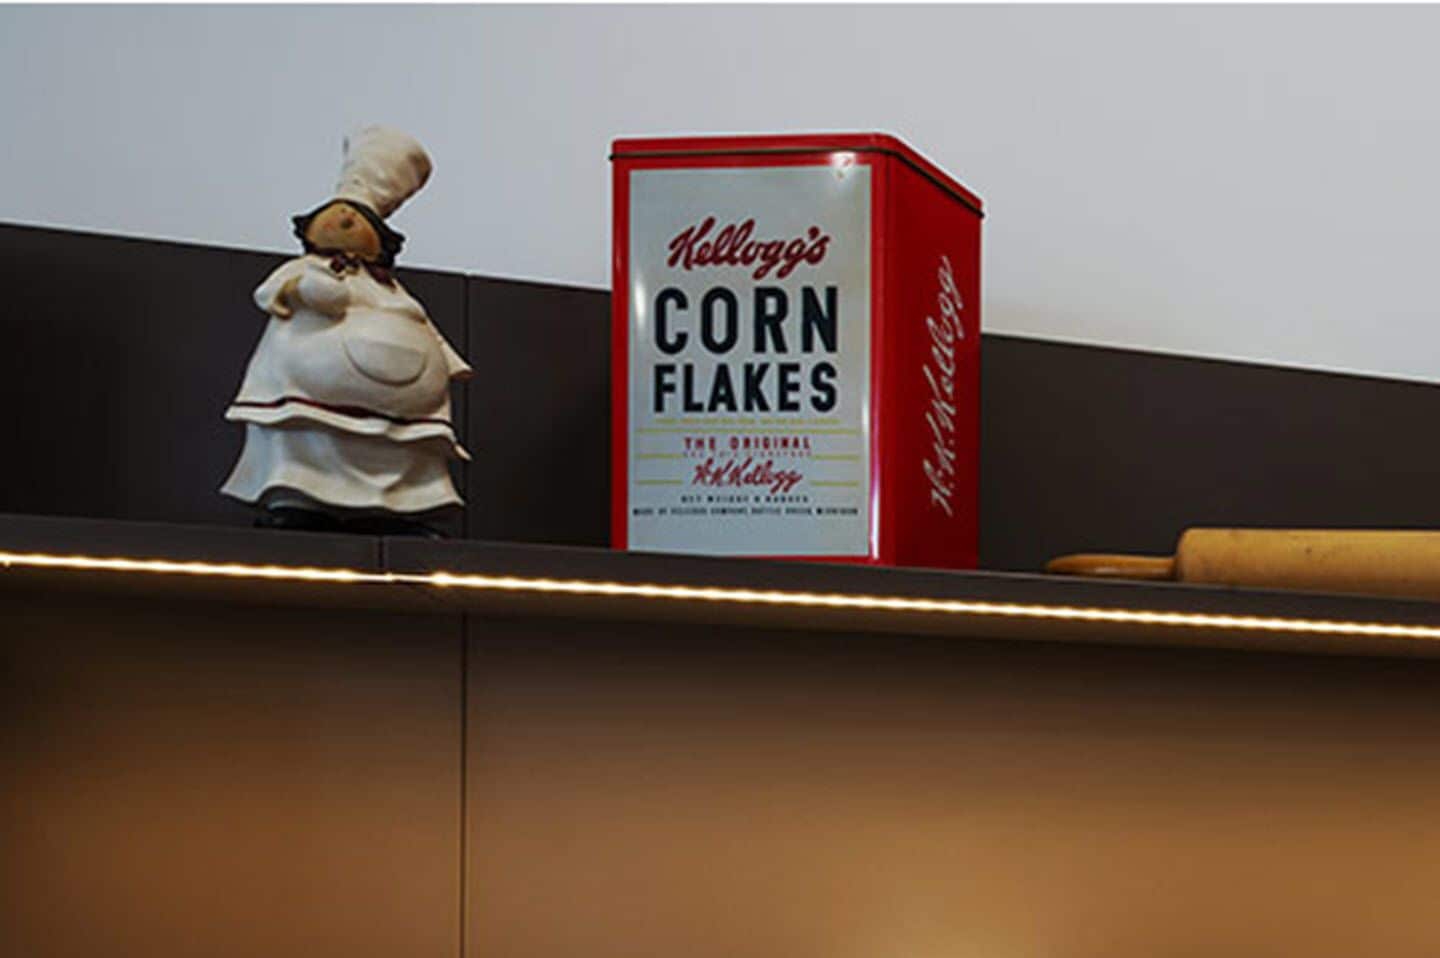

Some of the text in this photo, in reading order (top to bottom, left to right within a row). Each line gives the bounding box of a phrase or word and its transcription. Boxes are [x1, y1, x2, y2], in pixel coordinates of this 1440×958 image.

[667, 216, 831, 280] Kellogg's
[654, 286, 838, 355] CORN
[653, 361, 837, 413] FLAKES
[683, 435, 812, 450] THE ORIGINAL
